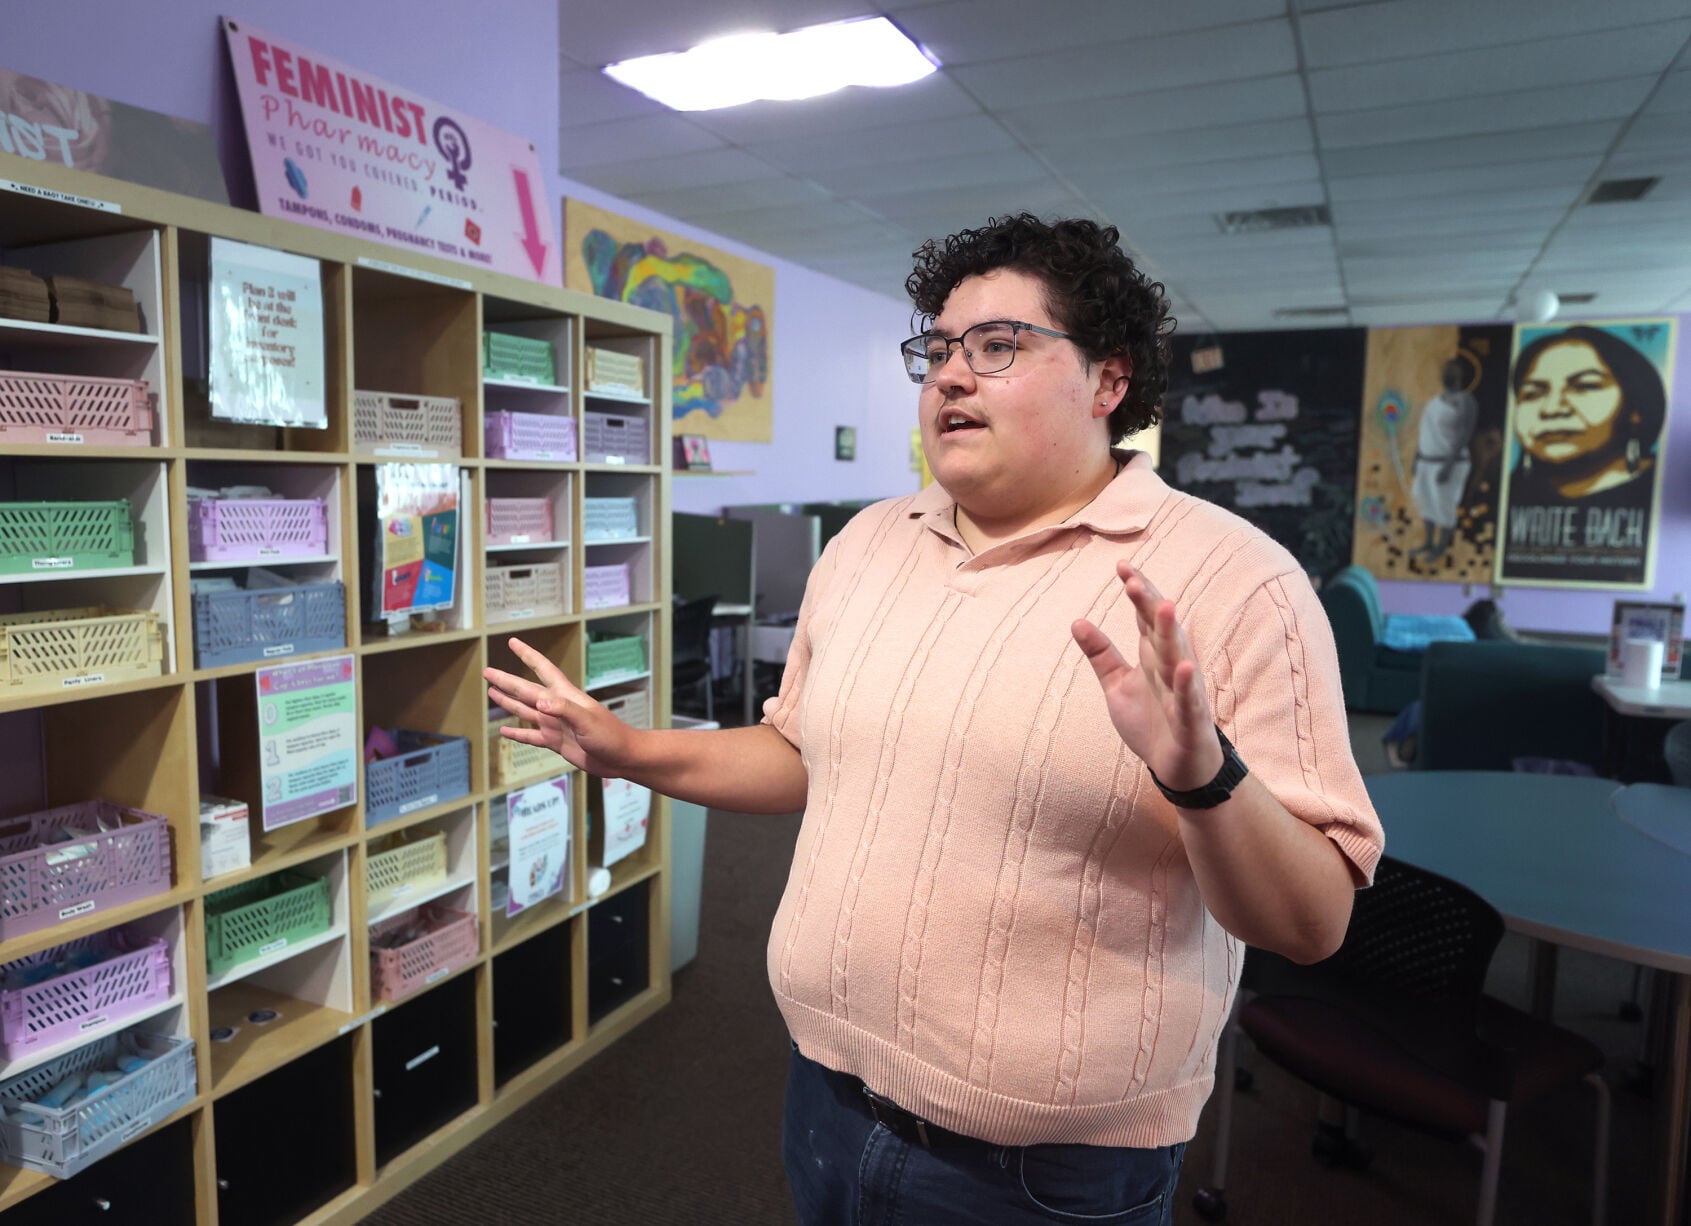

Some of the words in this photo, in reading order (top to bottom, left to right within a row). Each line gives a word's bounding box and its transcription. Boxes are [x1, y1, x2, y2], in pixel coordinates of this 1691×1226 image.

[248, 36, 427, 146] FEMINIST
[260, 94, 437, 181] Pharmacy
[266, 132, 287, 151] WE
[295, 140, 322, 162] GOT
[331, 153, 357, 173] YOU
[20, 185, 36, 194] NEED
[61, 194, 76, 203] TAKE
[278, 197, 333, 225] TAMPONS,
[334, 212, 385, 239] CONDOMS,
[386, 226, 435, 250] PREGNANCY
[242, 281, 266, 298] Plan
[277, 289, 296, 302] will
[276, 300, 292, 315] the
[262, 325, 279, 339] for
